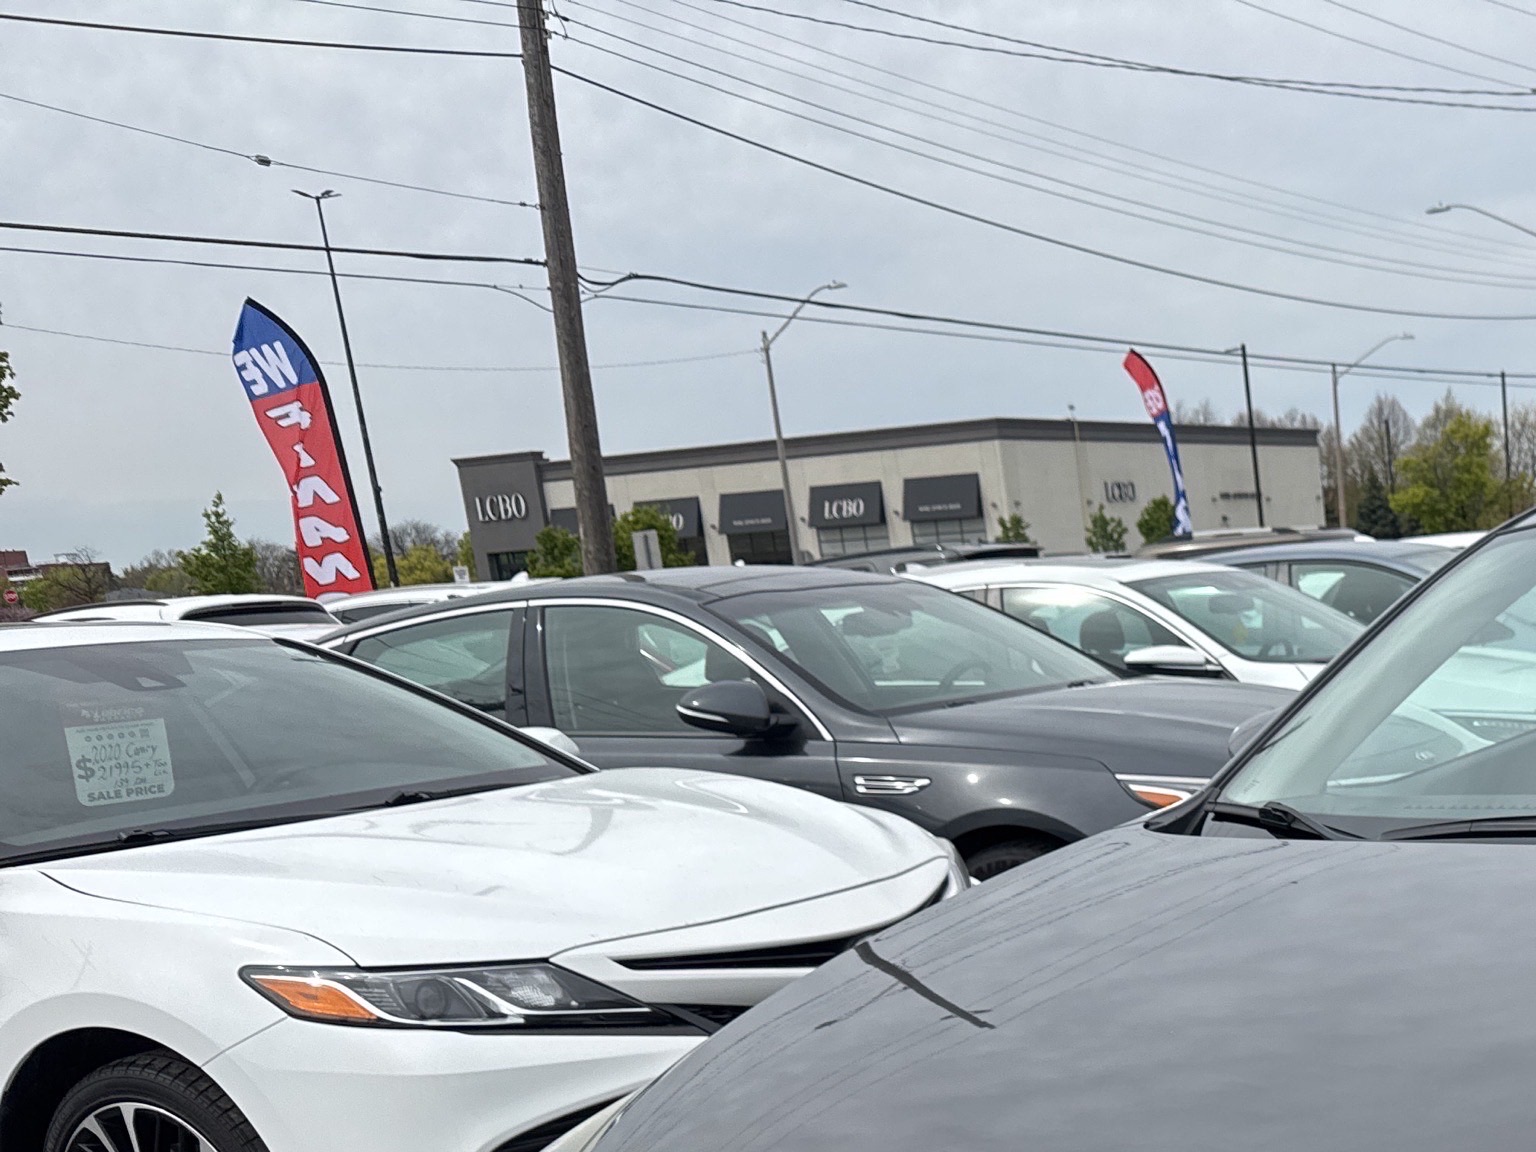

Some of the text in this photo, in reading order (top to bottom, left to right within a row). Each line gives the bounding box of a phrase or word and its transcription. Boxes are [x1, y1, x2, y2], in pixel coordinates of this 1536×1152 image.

[475, 491, 527, 523] LCBO
[824, 497, 865, 520] LCBO
[87, 789, 124, 803] SALE
[126, 783, 166, 798] PRICE
